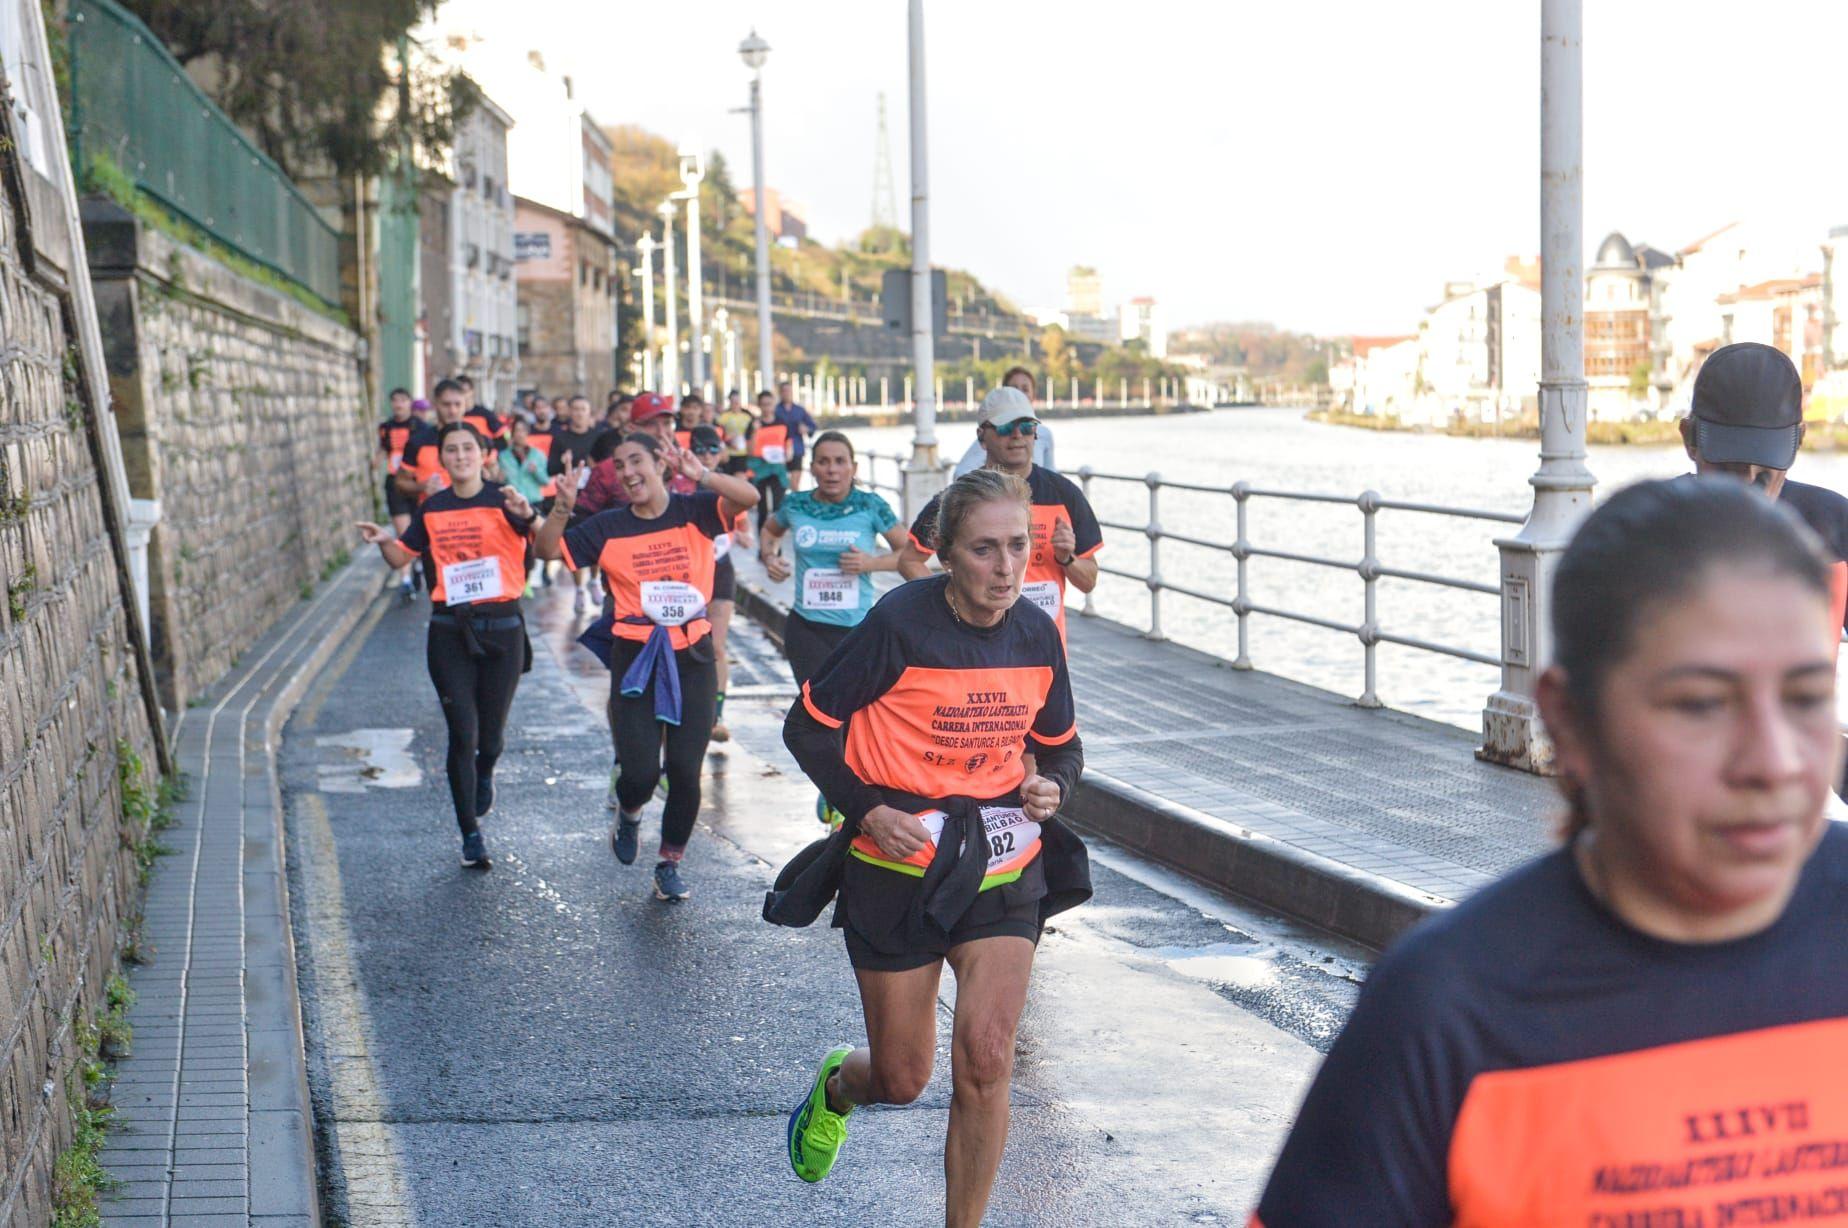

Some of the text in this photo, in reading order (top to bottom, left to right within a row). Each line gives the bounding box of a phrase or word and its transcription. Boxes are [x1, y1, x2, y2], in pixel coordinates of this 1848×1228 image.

[464, 581, 483, 593] 361
[819, 591, 842, 602] 1848
[662, 606, 685, 618] 358
[966, 692, 1007, 704] XXXVII
[931, 720, 970, 733] CARRERA
[959, 737, 996, 748] SANTURCE
[995, 737, 1000, 749] A
[985, 816, 1023, 832] BILBAO
[991, 831, 1016, 857] 82
